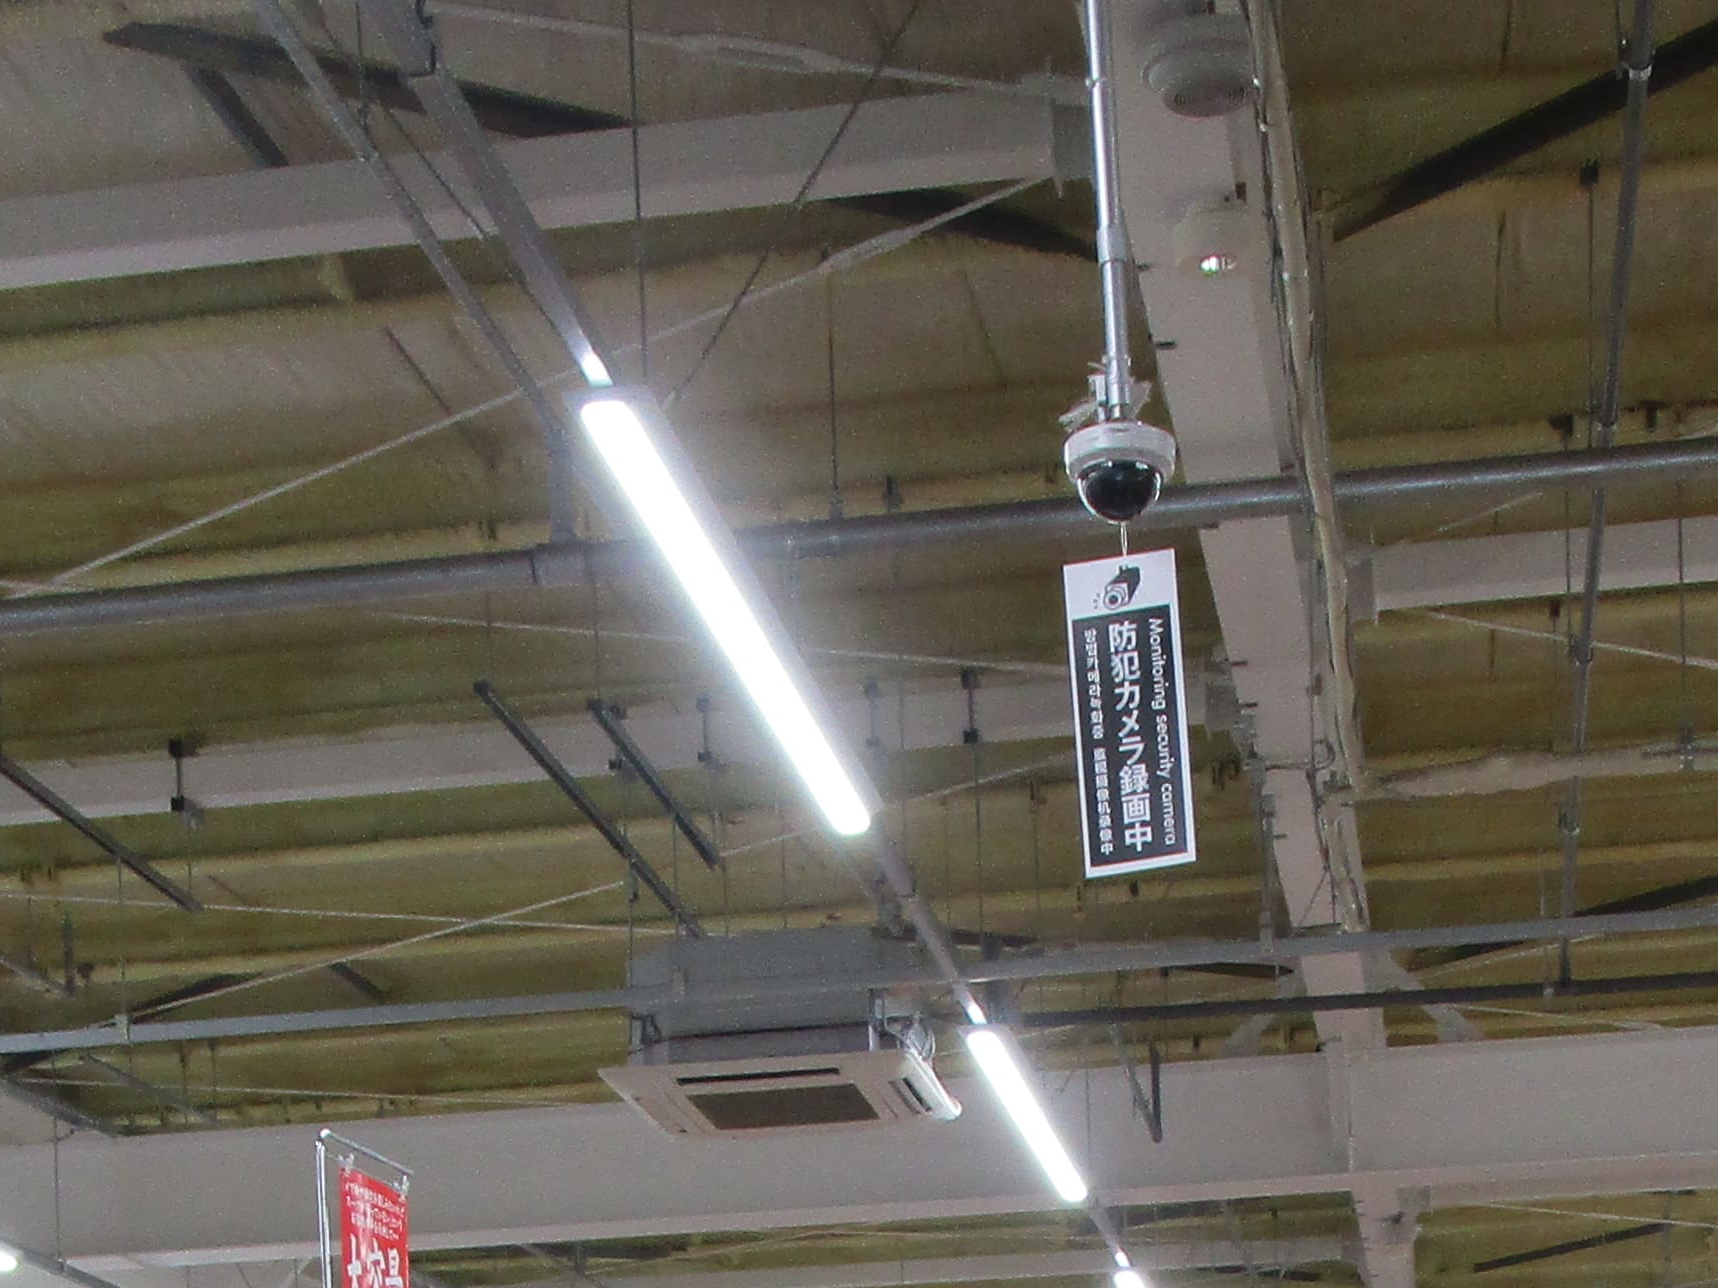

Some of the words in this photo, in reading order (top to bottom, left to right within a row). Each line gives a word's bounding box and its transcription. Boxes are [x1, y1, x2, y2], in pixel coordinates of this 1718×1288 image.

[1148, 618, 1168, 710] Monitoring
[1107, 620, 1153, 852] 防犯カメラ録画中
[1156, 714, 1175, 779] security
[1161, 783, 1176, 845] camera
